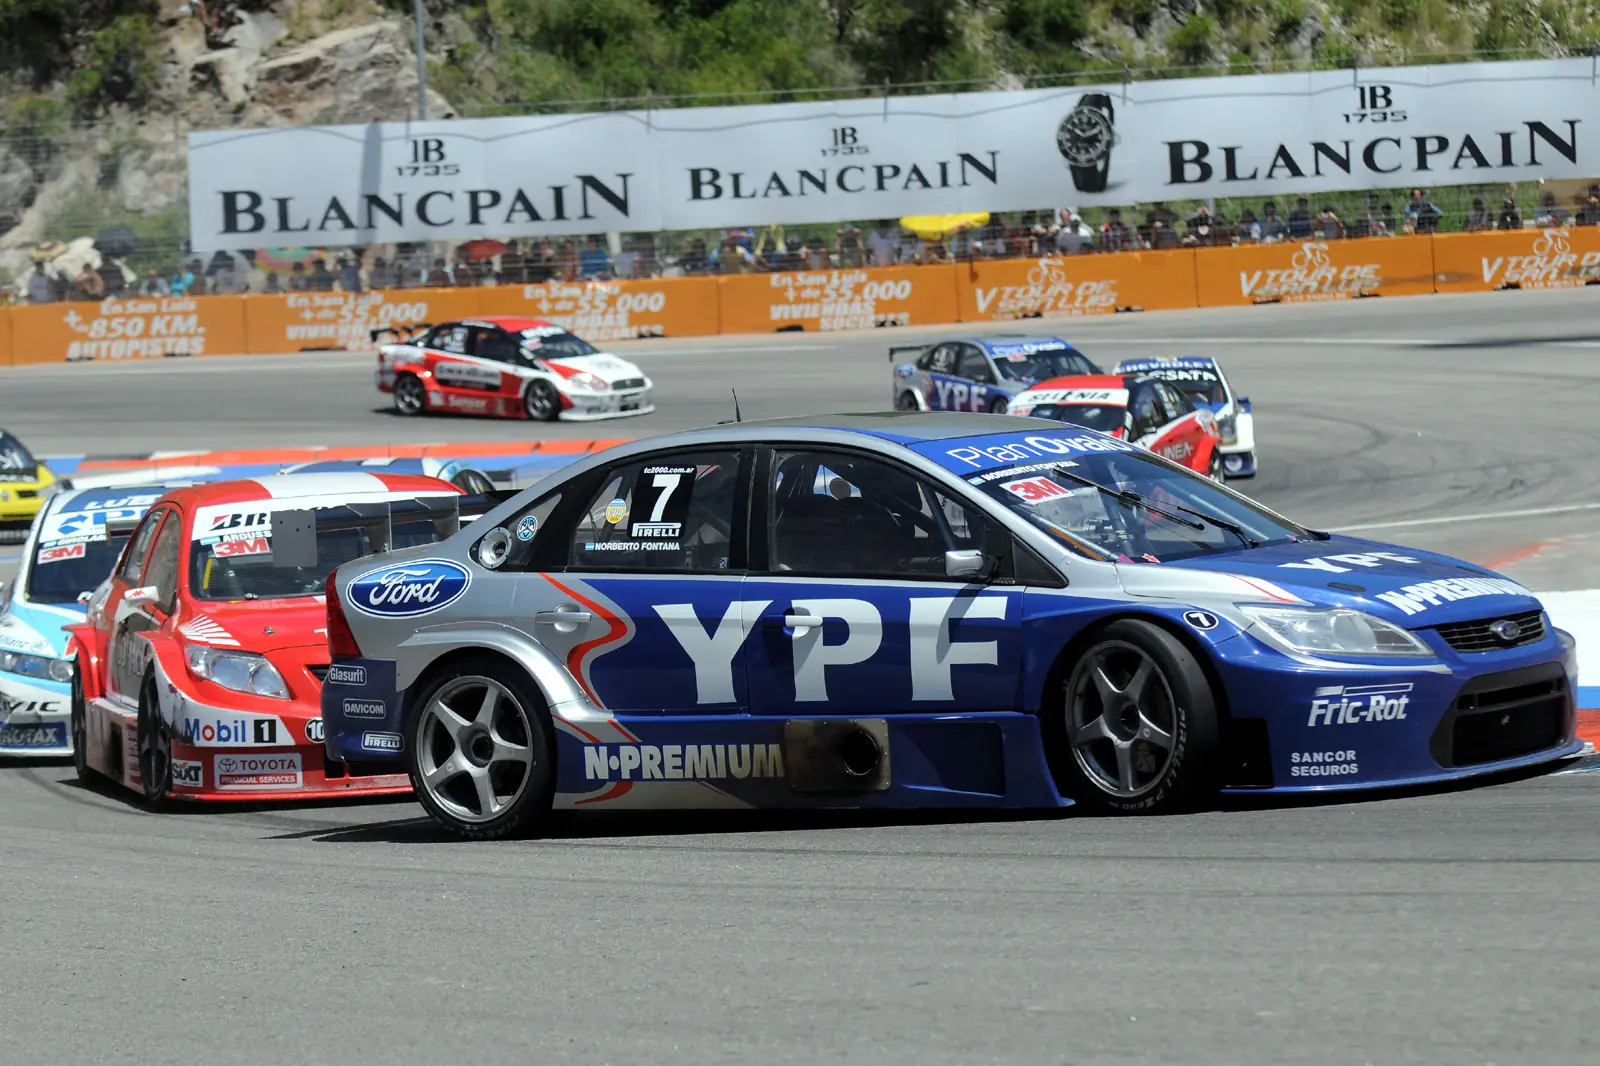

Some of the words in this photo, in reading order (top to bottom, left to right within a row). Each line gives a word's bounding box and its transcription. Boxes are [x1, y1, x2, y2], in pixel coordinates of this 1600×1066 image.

[1343, 110, 1408, 123] 1735
[820, 145, 869, 157] 1735
[1163, 119, 1582, 186] BLANCPAIN
[397, 164, 461, 177] 1735
[685, 150, 1001, 201] BLANCPAIN
[217, 173, 635, 235] BLANCPAIN
[88, 316, 145, 338] 850
[66, 336, 206, 360] AUTOPISTAS
[935, 380, 987, 412] YPF
[946, 443, 1038, 468] Plan
[1024, 434, 1133, 455] Ovalo
[643, 466, 695, 474] tc2000.com.ar
[981, 464, 1037, 482] NORBERTO
[650, 474, 681, 522] 7
[1010, 480, 1069, 501] 3M
[632, 523, 682, 537] PIRELLI
[40, 544, 83, 561] 3M
[215, 538, 270, 556] 3M
[594, 542, 639, 551] NORBERTO
[641, 542, 680, 551] FONTANA
[1277, 552, 1420, 573] YPF
[369, 568, 446, 606] Ford
[1188, 612, 1211, 627] 7
[651, 596, 1008, 704] YPF
[330, 667, 364, 683] Glasurit
[344, 702, 385, 715] DAVICOM
[1308, 695, 1409, 726] Fric-Rot
[185, 718, 246, 743] Mobil
[260, 720, 270, 742] 1
[365, 733, 400, 748] PIRELLI
[239, 758, 297, 771] TOYOTA
[1291, 750, 1356, 763] SANCOR
[1290, 764, 1358, 776] SEGUROS
[221, 775, 258, 784] FINANCIAL
[258, 775, 296, 784] SERVICES
